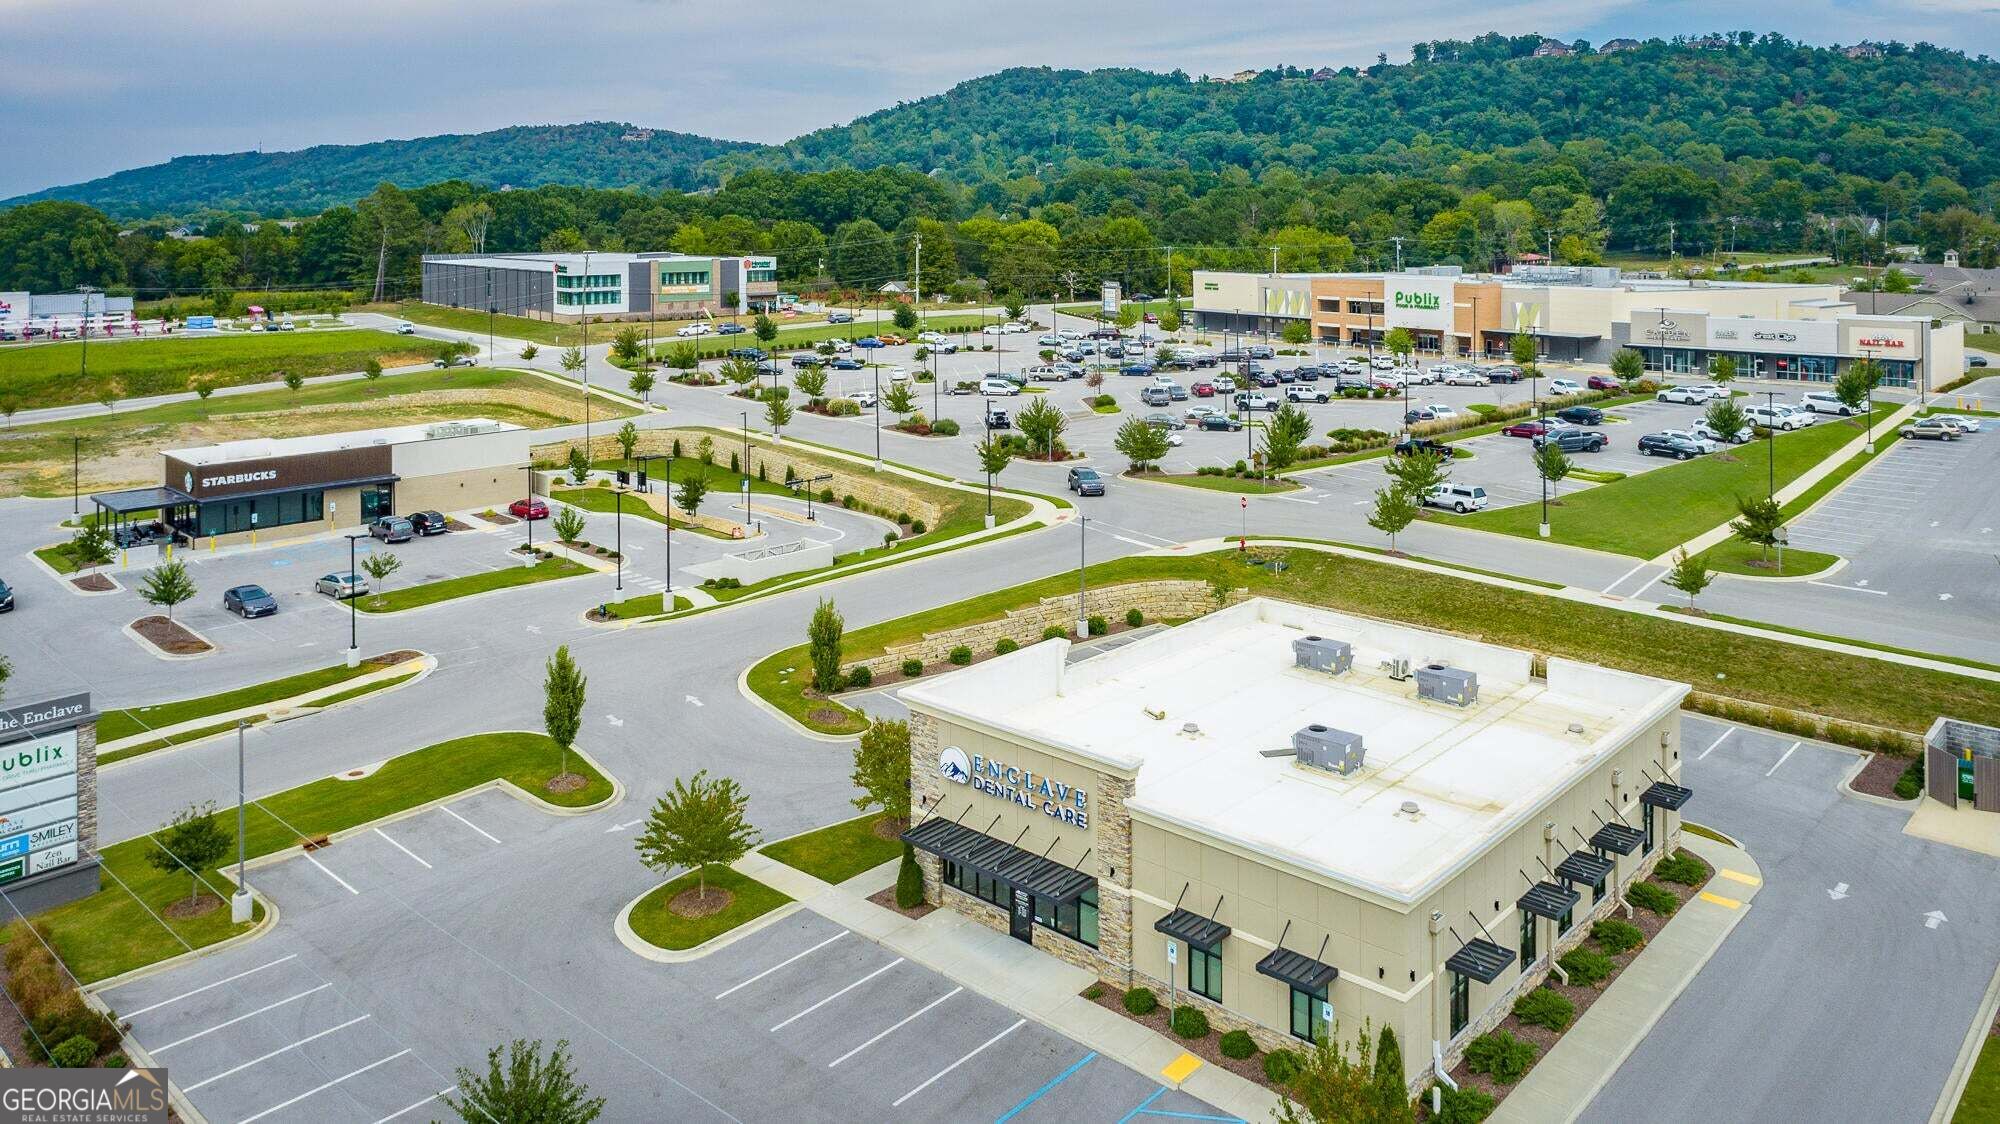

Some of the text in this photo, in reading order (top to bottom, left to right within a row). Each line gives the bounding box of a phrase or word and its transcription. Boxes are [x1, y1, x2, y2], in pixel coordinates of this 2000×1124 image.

[1395, 291, 1440, 305] Publix
[1753, 331, 1796, 342] Great Clips
[1859, 338, 1905, 348] NAIL BAR
[202, 470, 277, 487] STARBUCKS
[22, 704, 83, 725] Enclave
[973, 753, 1087, 808] ENCLAVE
[973, 775, 1088, 829] DENTAL CARE
[30, 823, 75, 844] SMILEY
